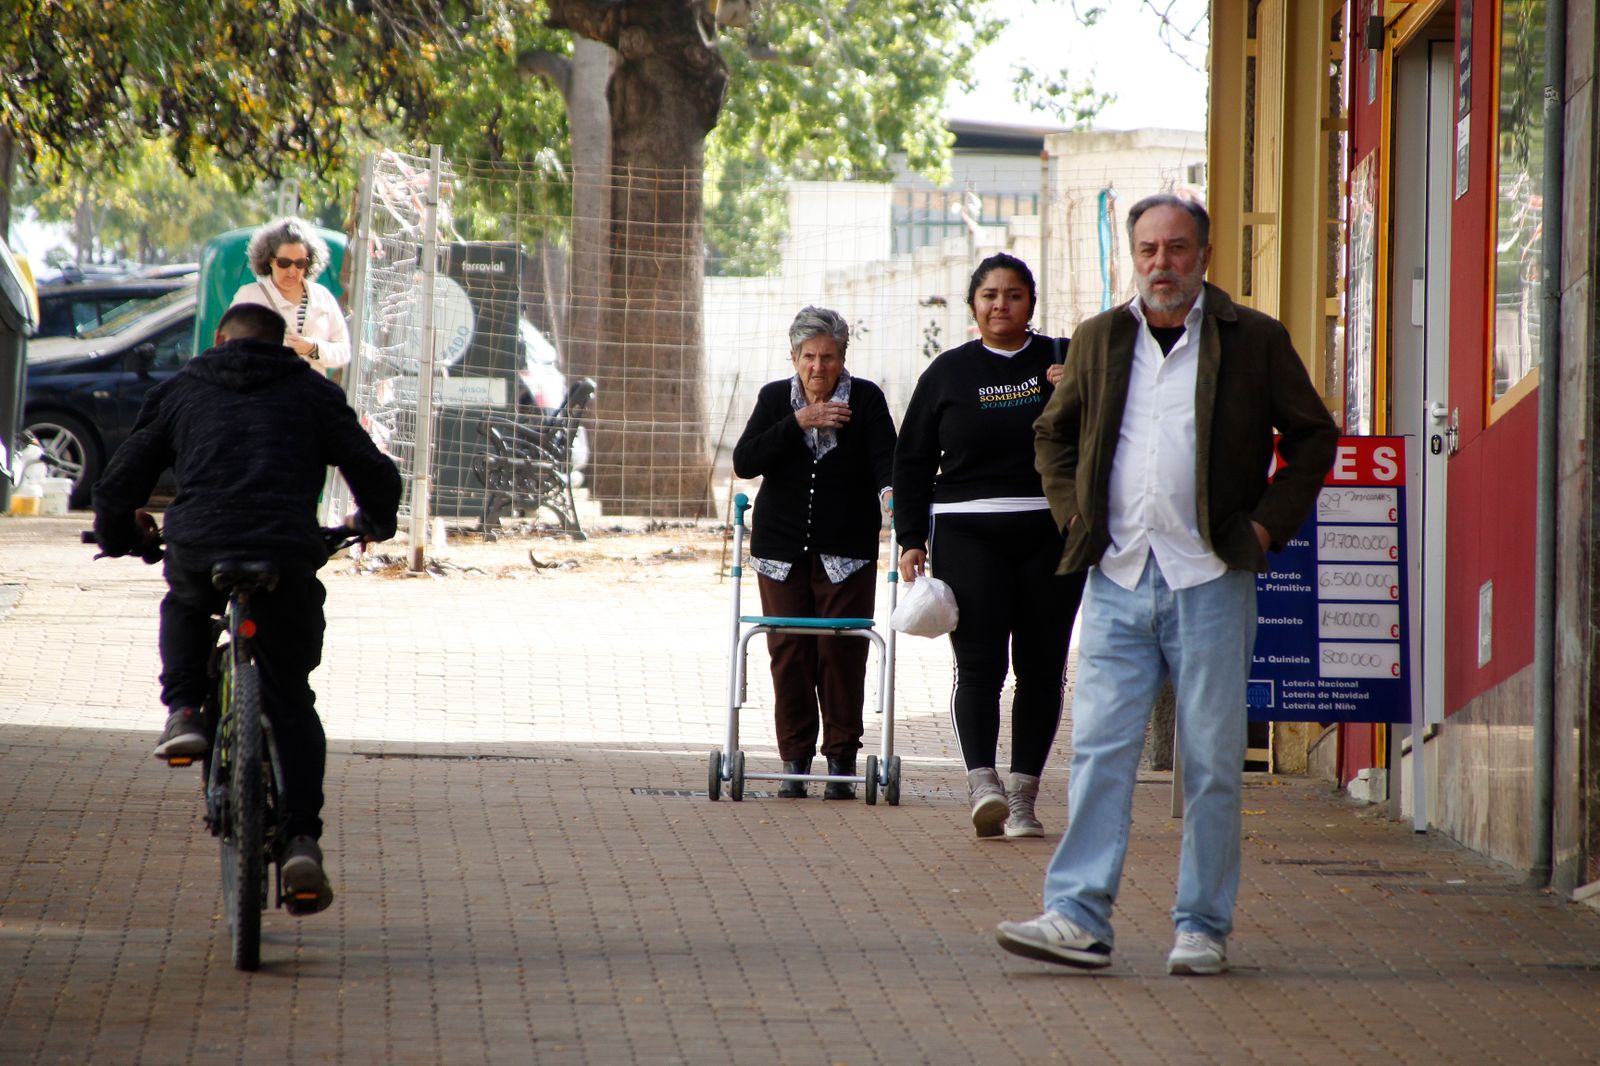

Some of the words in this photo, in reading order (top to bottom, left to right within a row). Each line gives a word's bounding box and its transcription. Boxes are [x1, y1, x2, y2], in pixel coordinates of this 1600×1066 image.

[462, 260, 504, 272] ferrovial
[978, 377, 1039, 396] SOMEHOW
[980, 385, 1041, 403] SOMEHOW
[981, 395, 1041, 409] SOMEHOW
[1333, 446, 1398, 481] ES
[1320, 493, 1341, 510] 29
[1270, 571, 1302, 580] Gordo
[1265, 583, 1312, 592] Primitiva
[1257, 616, 1304, 625] Bonoloto
[1252, 655, 1266, 663] La
[1268, 655, 1311, 664] Quiniela
[1282, 680, 1315, 688] Lotería
[1317, 680, 1359, 688] Nacional
[1282, 691, 1316, 699] Lotería
[1318, 691, 1329, 699] de
[1331, 692, 1370, 700] Navidad
[1282, 702, 1316, 710] Lotería
[1318, 702, 1333, 710] del
[1334, 702, 1357, 711] Niño
